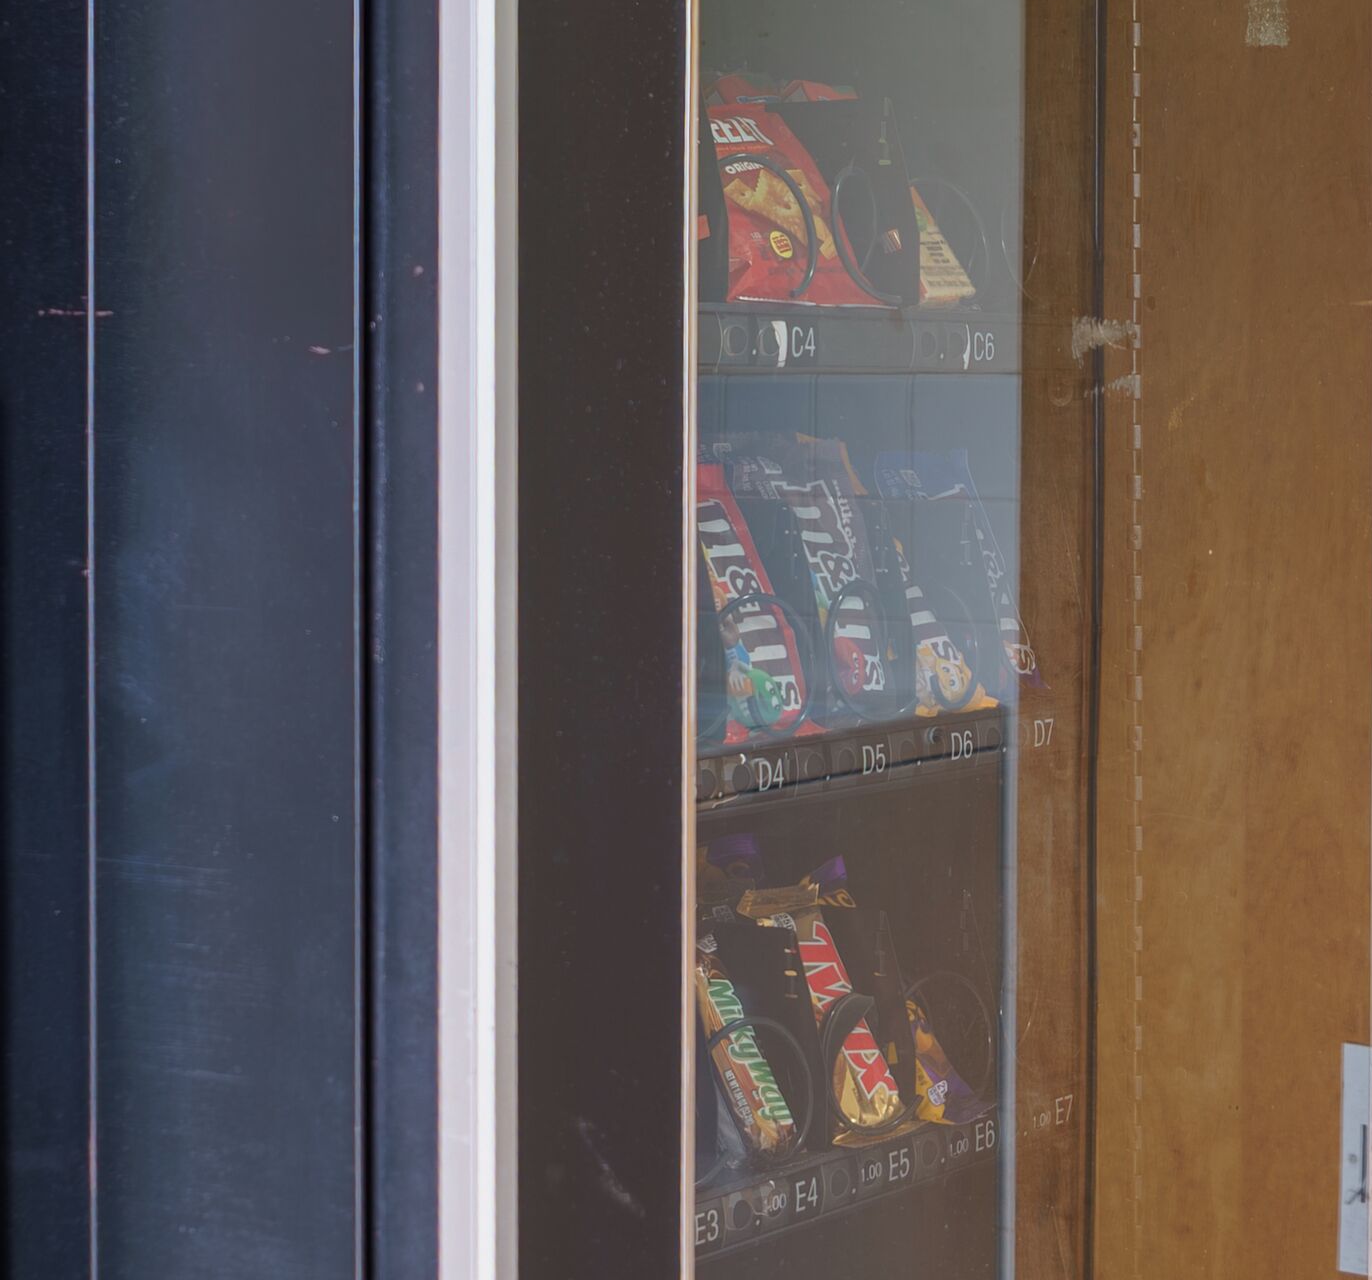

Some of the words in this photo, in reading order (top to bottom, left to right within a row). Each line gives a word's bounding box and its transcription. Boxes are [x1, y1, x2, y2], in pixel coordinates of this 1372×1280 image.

[791, 326, 816, 358] C4
[973, 332, 995, 361] C6
[951, 730, 973, 761] D6
[1034, 718, 1054, 748] D7
[758, 757, 785, 792] D4
[862, 745, 886, 776] D5
[1033, 1111, 1051, 1128] 1.00
[1055, 1094, 1074, 1126] E7
[949, 1137, 969, 1157] 1.00
[975, 1120, 996, 1152] E6
[860, 1162, 882, 1182] 1.00
[889, 1148, 910, 1181] E5
[795, 1177, 818, 1213] E4
[695, 1209, 720, 1244] E3
